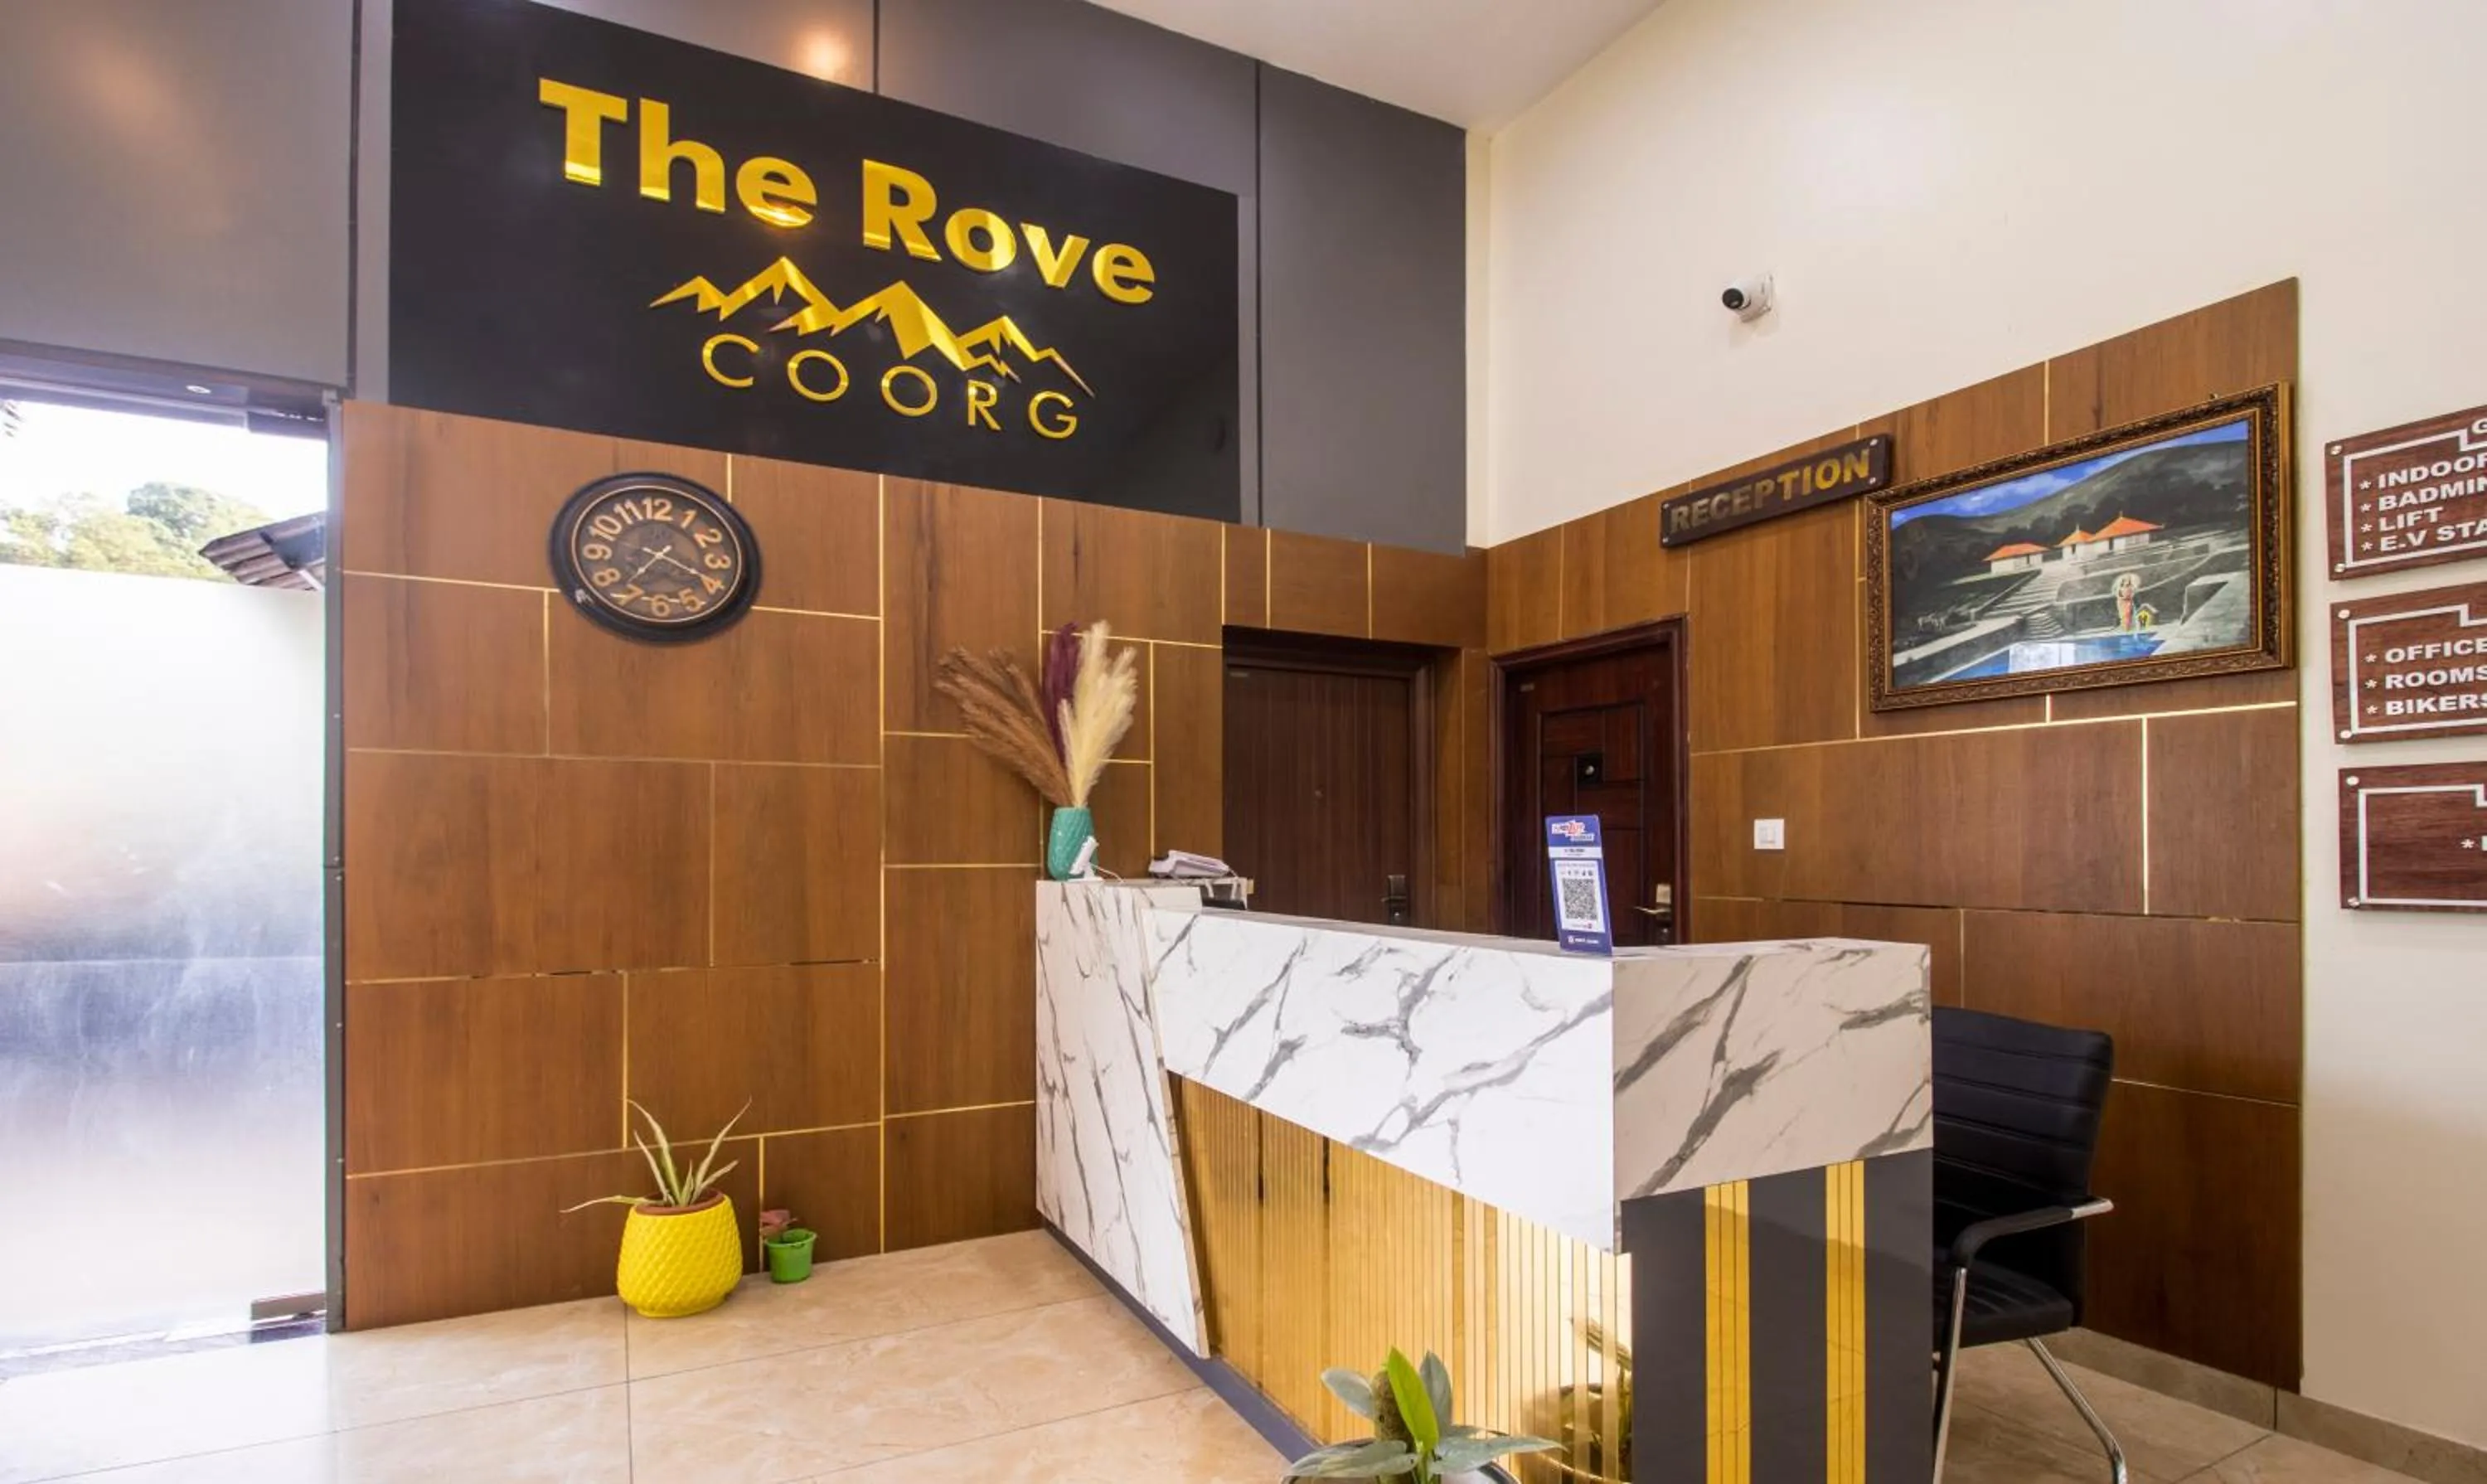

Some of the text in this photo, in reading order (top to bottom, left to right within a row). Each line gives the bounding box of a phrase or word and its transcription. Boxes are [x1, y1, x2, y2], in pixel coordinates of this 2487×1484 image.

[540, 77, 1156, 304] The Rove
[702, 332, 1078, 439] COORG
[1670, 449, 1870, 534] RECEPTION
[613, 499, 643, 525] 11
[642, 497, 673, 521] 12
[681, 509, 697, 529] 1
[2378, 507, 2444, 531] LIFT
[589, 514, 622, 541] 10
[693, 528, 723, 548] 2
[2436, 518, 2487, 542] STA
[583, 543, 612, 560] 9
[705, 553, 731, 570] 3
[593, 568, 621, 587] 8
[701, 574, 725, 595] 4
[619, 584, 645, 606] 7
[651, 594, 671, 618] 6
[678, 588, 703, 613] 5
[2385, 637, 2487, 663] OFFICE
[2385, 664, 2487, 690] ROOMS
